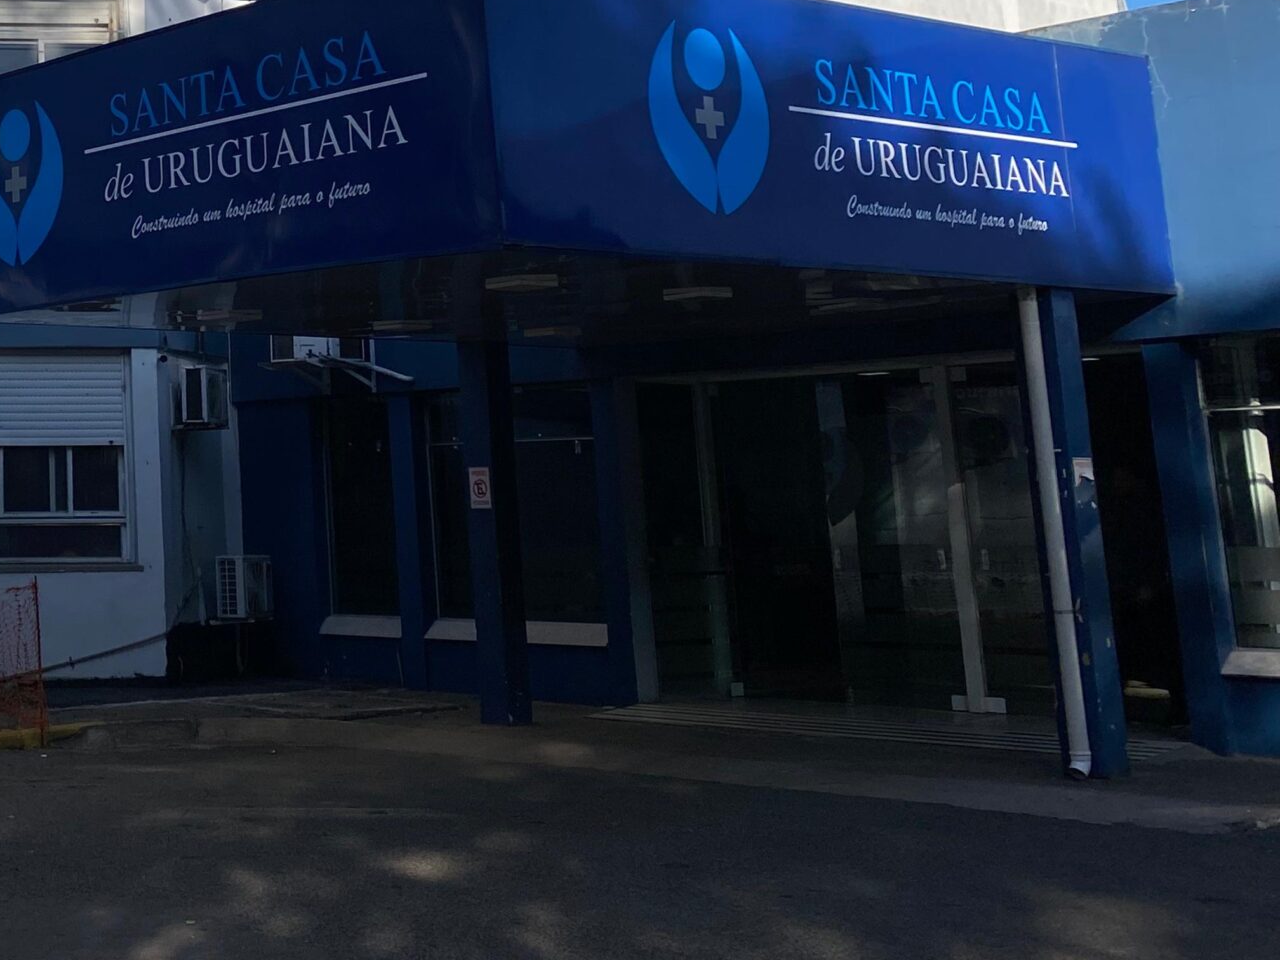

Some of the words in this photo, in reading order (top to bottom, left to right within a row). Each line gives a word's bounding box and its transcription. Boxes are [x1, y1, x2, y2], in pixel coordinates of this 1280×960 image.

[109, 65, 247, 137] SANTA
[255, 30, 388, 101] CASA
[814, 59, 946, 121] SANTA
[951, 80, 1052, 134] CASA
[104, 162, 134, 202] de
[142, 104, 409, 193] URUGUAIANA
[814, 132, 845, 173] de
[851, 136, 1070, 198] URUGUAIANA
[131, 208, 199, 239] Construindo
[203, 209, 222, 222] um
[226, 193, 276, 222] hospital
[279, 193, 312, 215] para
[316, 190, 324, 203] o
[328, 181, 371, 209] futuro
[846, 194, 913, 218] Construindo
[915, 209, 933, 221] um
[935, 203, 978, 228] hospital
[979, 212, 1006, 230] para
[1008, 217, 1015, 228] o
[1017, 213, 1049, 236] futuro
